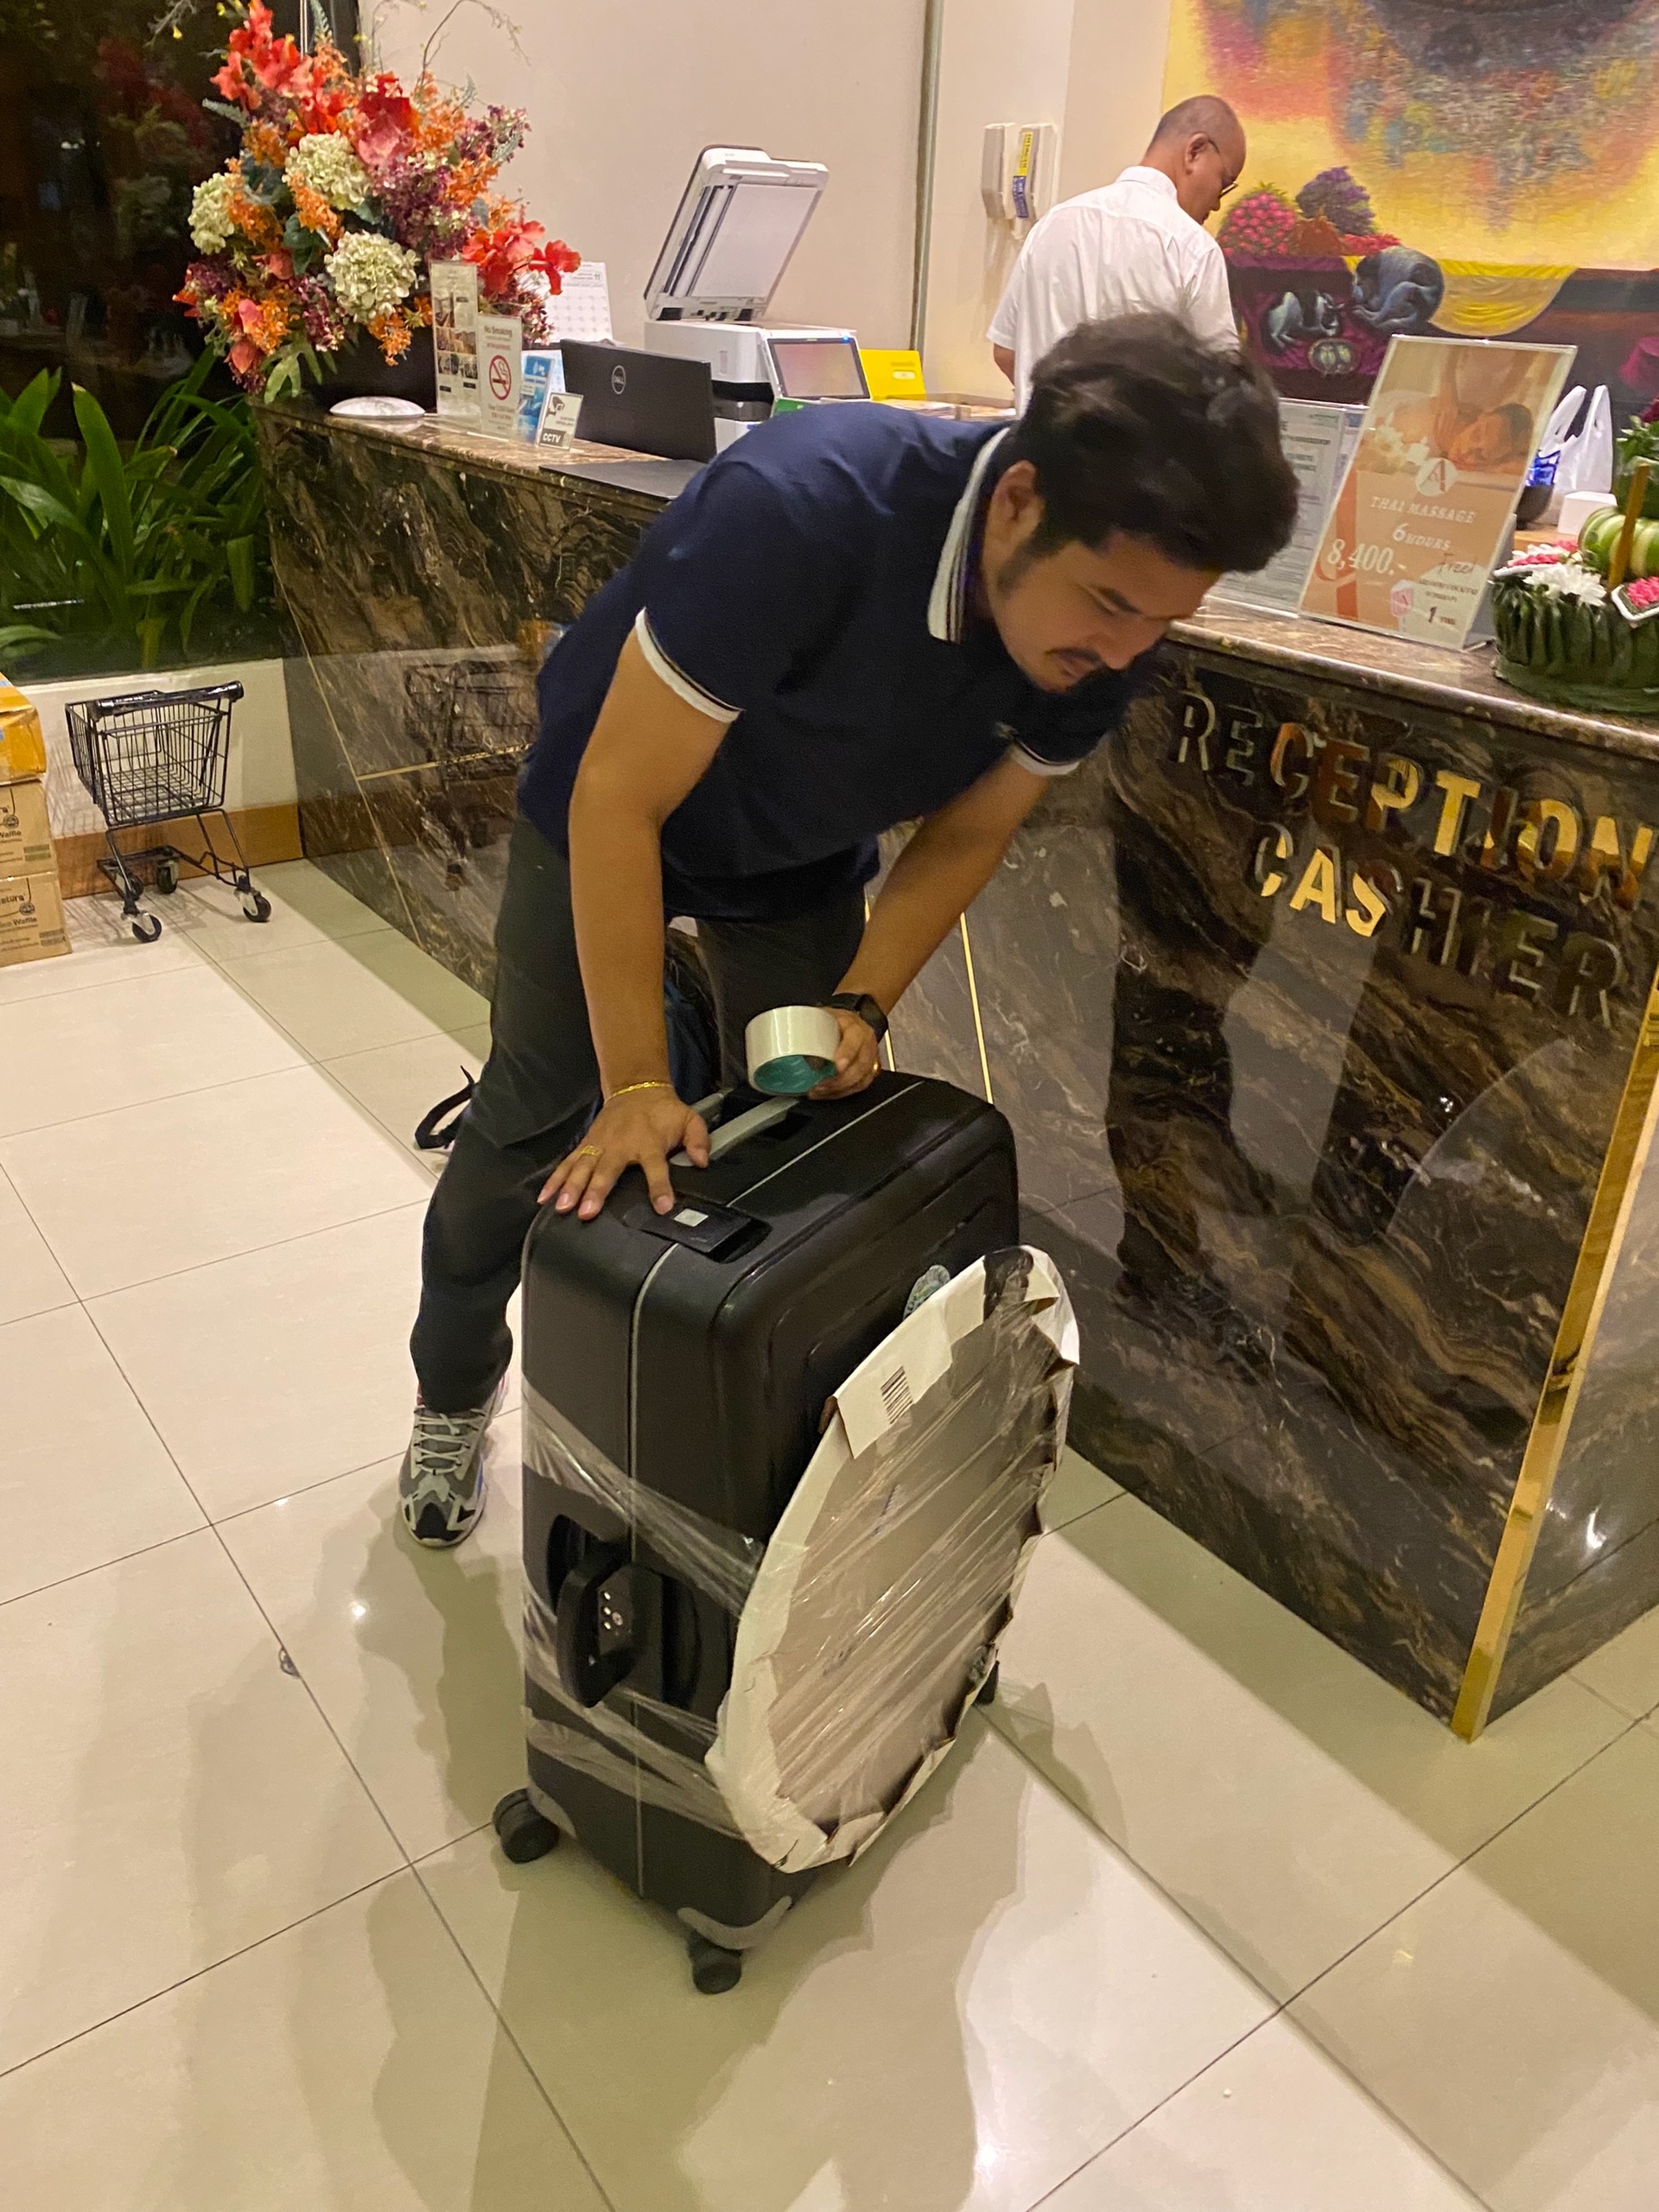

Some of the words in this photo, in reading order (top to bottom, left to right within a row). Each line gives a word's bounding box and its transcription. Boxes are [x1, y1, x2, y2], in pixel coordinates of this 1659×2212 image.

[542, 432, 562, 444] CCTV
[1370, 496, 1403, 512] THAI
[1407, 502, 1477, 524] MASSAGE
[1392, 523, 1409, 542] 6
[1404, 533, 1452, 550] HOURS
[1327, 538, 1408, 575] 8,400.-
[1172, 691, 1657, 911] RECEPTION
[1255, 822, 1624, 1028] CASHIER
